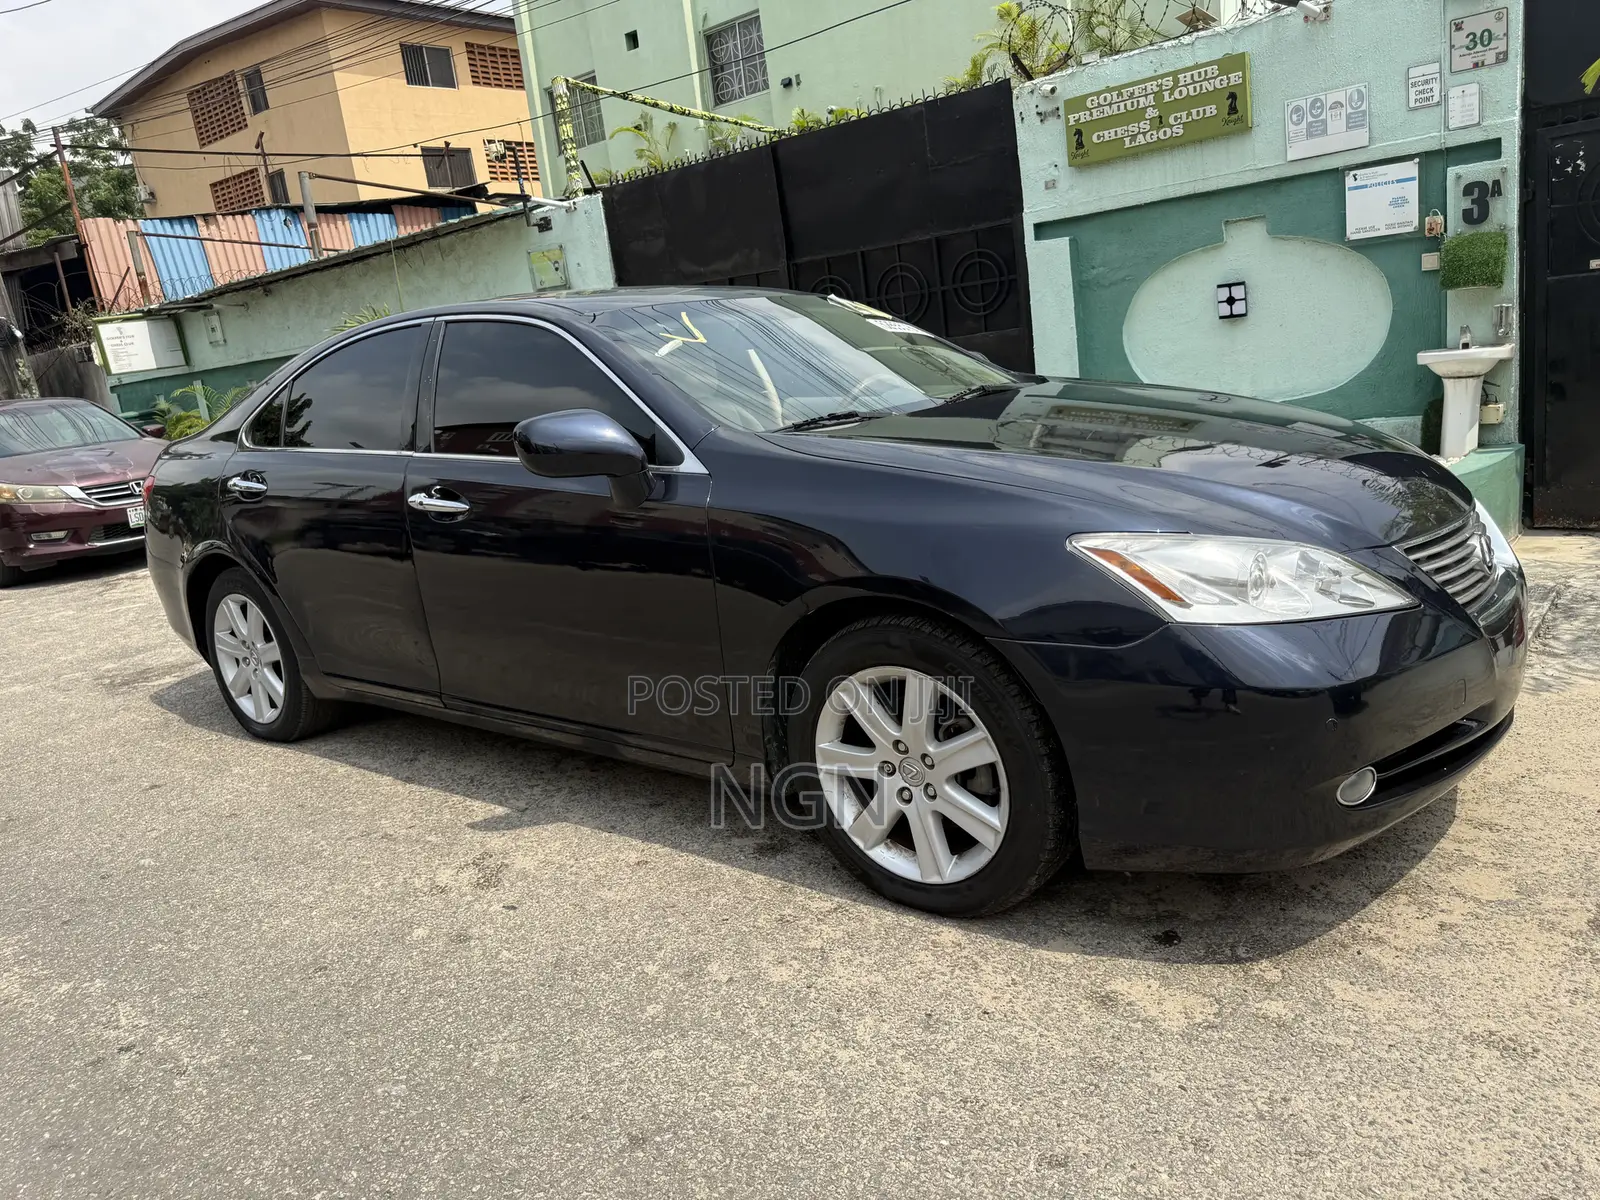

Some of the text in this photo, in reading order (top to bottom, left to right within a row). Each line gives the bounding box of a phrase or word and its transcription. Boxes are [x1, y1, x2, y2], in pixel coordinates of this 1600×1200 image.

[1465, 28, 1493, 51] 30
[1086, 65, 1219, 109] GOLFER'S HUB
[1410, 77, 1438, 89] SECURITY
[1414, 87, 1434, 97] CHECK
[1068, 71, 1243, 126] PREMIUM LOUNGE
[1414, 95, 1435, 105] POINT
[1092, 104, 1218, 144] CHESS CLUB
[1145, 107, 1160, 120] &
[1123, 124, 1184, 149] LAGOS
[1462, 179, 1503, 226] 3A
